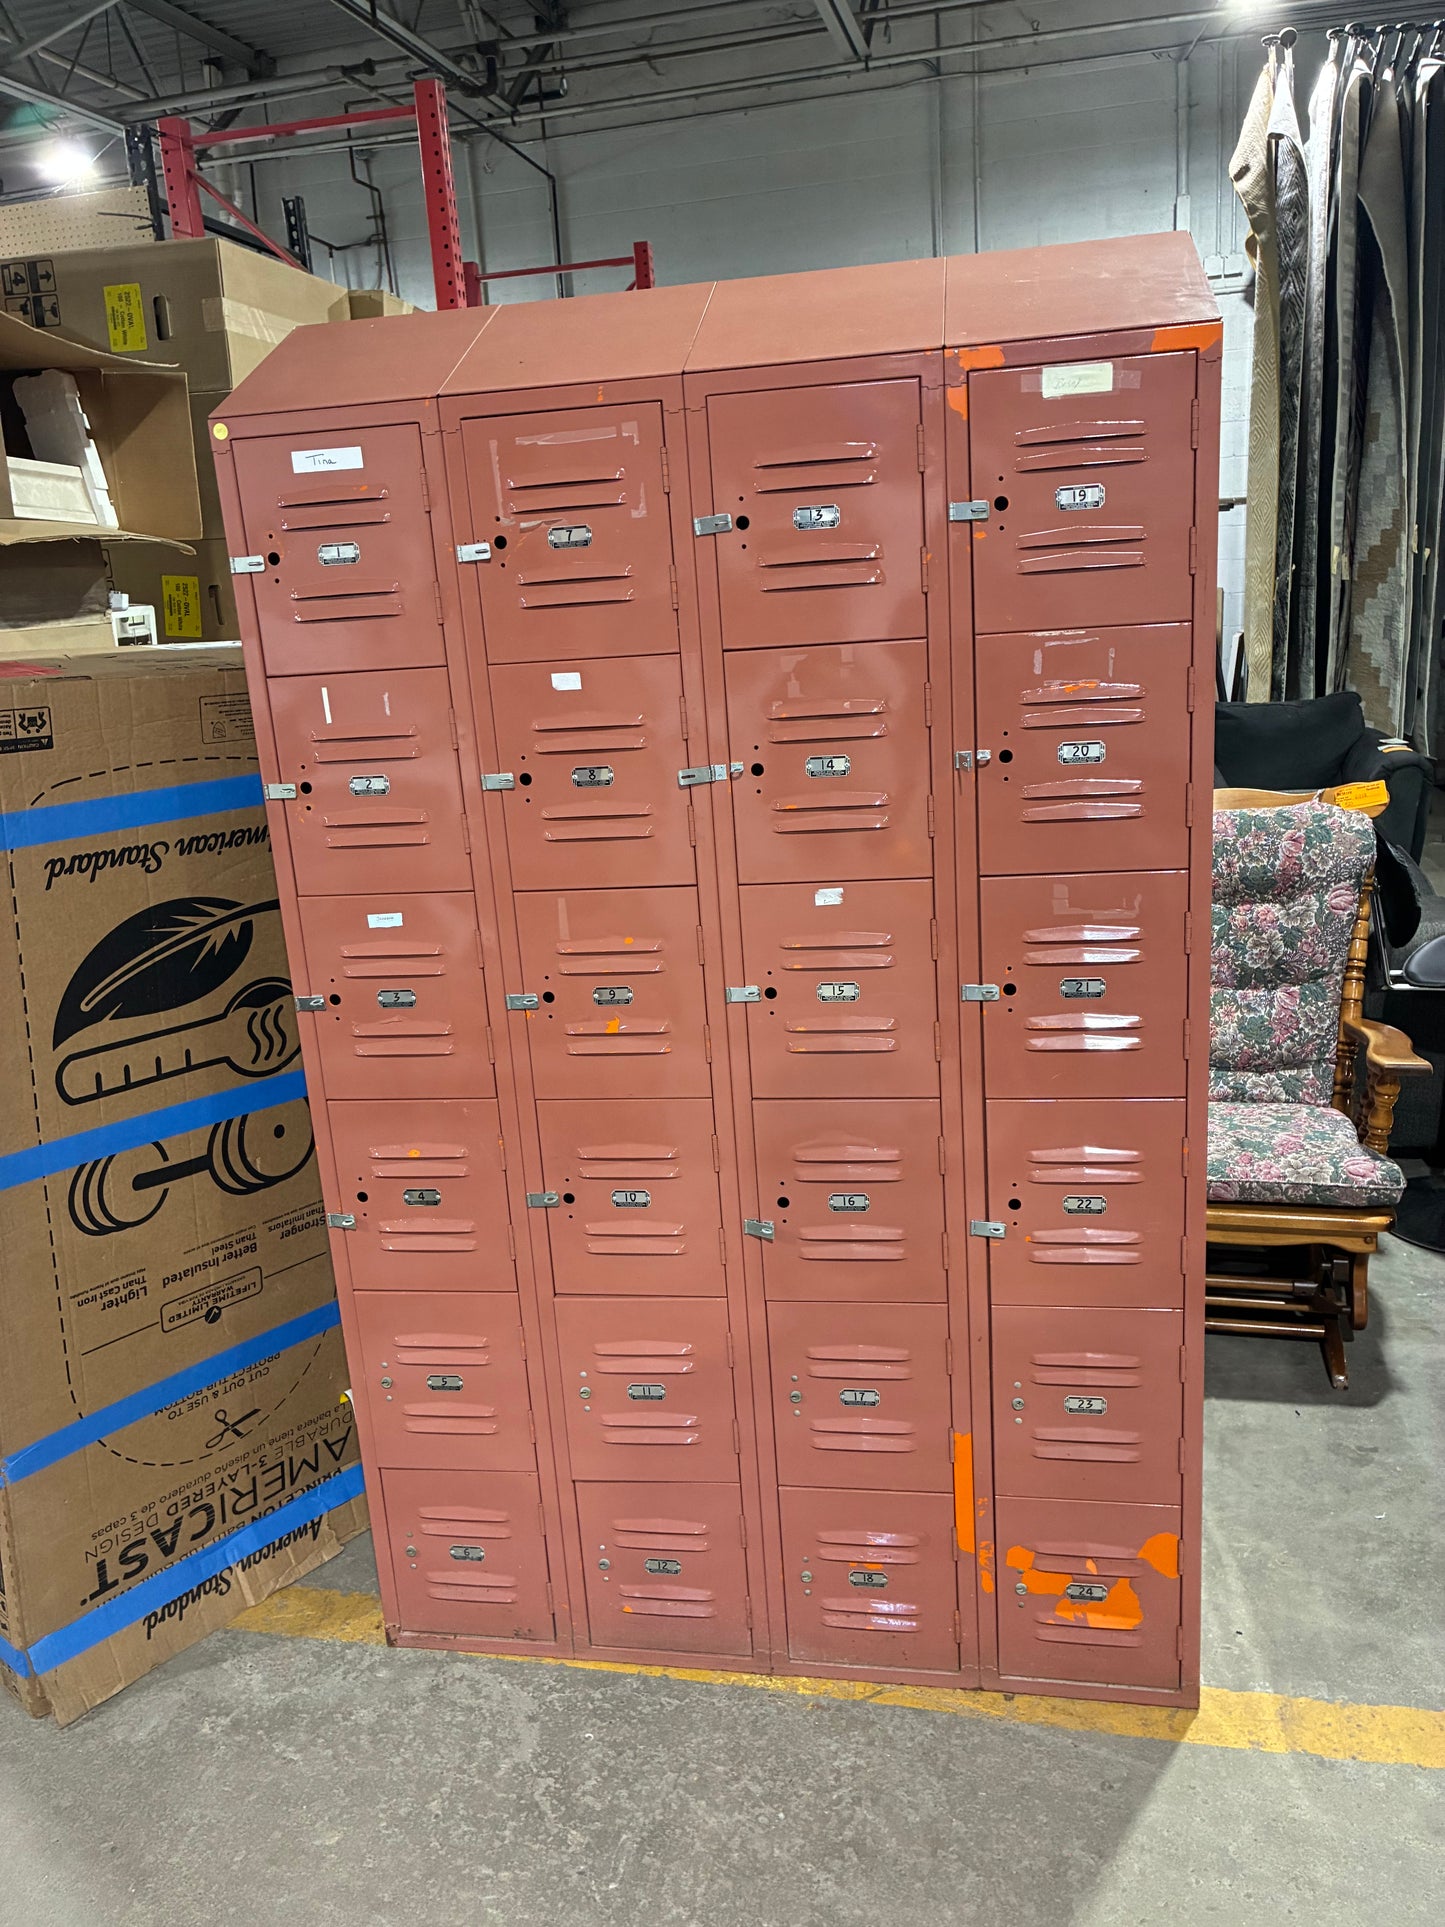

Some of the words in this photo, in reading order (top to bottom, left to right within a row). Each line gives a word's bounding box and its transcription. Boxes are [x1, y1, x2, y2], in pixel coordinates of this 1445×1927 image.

[1073, 489, 1086, 502] 19
[809, 509, 823, 521] 13
[566, 530, 572, 541] 7
[1072, 746, 1089, 756] 20
[821, 759, 835, 770] 14
[588, 769, 596, 780] 8
[365, 779, 372, 789] 2
[175, 825, 272, 856] merican
[44, 841, 169, 890] Standard
[833, 985, 844, 996] 15
[1075, 982, 1089, 992] 21
[393, 992, 400, 1002] 3
[609, 989, 616, 1000] 9
[418, 1192, 425, 1200] 4
[624, 1193, 636, 1202] 10
[843, 1197, 855, 1206] 16
[1077, 1199, 1092, 1209] 22
[268, 1214, 304, 1232] Imitators
[280, 1216, 326, 1239] Stronger
[236, 1232, 256, 1244] Than
[212, 1241, 233, 1255] Steel
[222, 1242, 257, 1262] Better
[163, 1257, 219, 1288] Insulated
[123, 1276, 146, 1289] Than
[100, 1286, 120, 1300] Cast
[101, 1286, 147, 1311] Lighter
[192, 1286, 233, 1306] WARRANTY
[212, 1282, 256, 1305] LIFETIME
[78, 1294, 97, 1307] Iron
[169, 1301, 208, 1323] LIMITED
[249, 1367, 269, 1382] CUT
[223, 1378, 245, 1394] OUT
[441, 1377, 448, 1386] 5
[212, 1390, 219, 1398] &
[642, 1387, 651, 1395] 11
[854, 1392, 865, 1401] 17
[187, 1396, 208, 1412] USE
[334, 1403, 345, 1412] La
[1078, 1399, 1093, 1408] 23
[168, 1408, 184, 1420] TO
[297, 1410, 331, 1431] bañera
[269, 1429, 293, 1445] tiene
[275, 1410, 354, 1460] DURABLE
[253, 1443, 265, 1454] un
[215, 1452, 250, 1474] diseño
[160, 1472, 211, 1503] duradero
[167, 1455, 267, 1516] 3-LAYERED
[141, 1502, 156, 1513] de
[131, 1512, 137, 1521] 3
[92, 1518, 126, 1540] capas
[85, 1512, 158, 1563] DESIGN
[237, 1514, 323, 1572] American
[464, 1548, 470, 1556] 6
[863, 1574, 874, 1582] 18
[1079, 1587, 1093, 1596] 24
[143, 1566, 233, 1640] Standard
